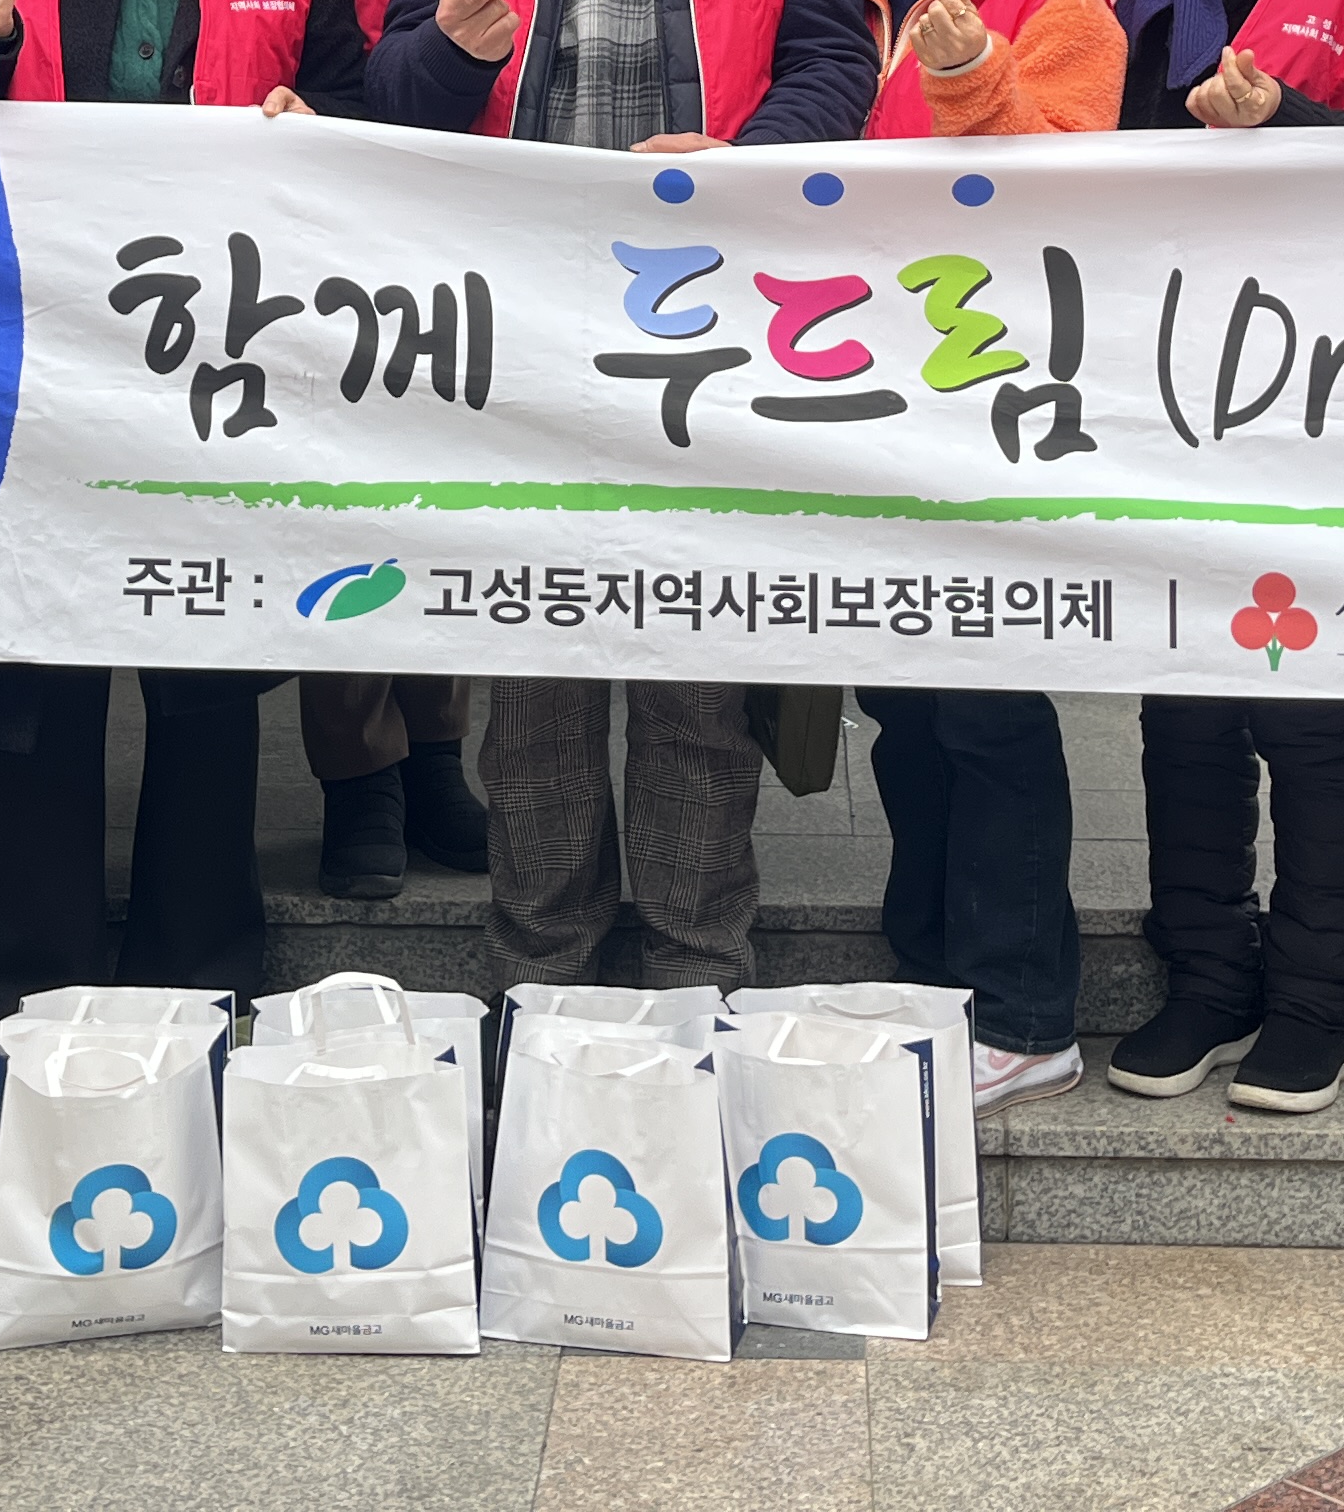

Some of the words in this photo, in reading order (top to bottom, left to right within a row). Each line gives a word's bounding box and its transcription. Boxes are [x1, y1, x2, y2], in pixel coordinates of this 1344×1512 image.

[107, 231, 494, 441] 함께
[592, 241, 1098, 464] 두드림
[122, 557, 232, 616] 주관
[423, 565, 1113, 641] 고성동지역사회보장협의체
[762, 1291, 835, 1307] MG새마을금고
[309, 1324, 383, 1337] MG새마을금고
[563, 1313, 635, 1331] MG새마을금고
